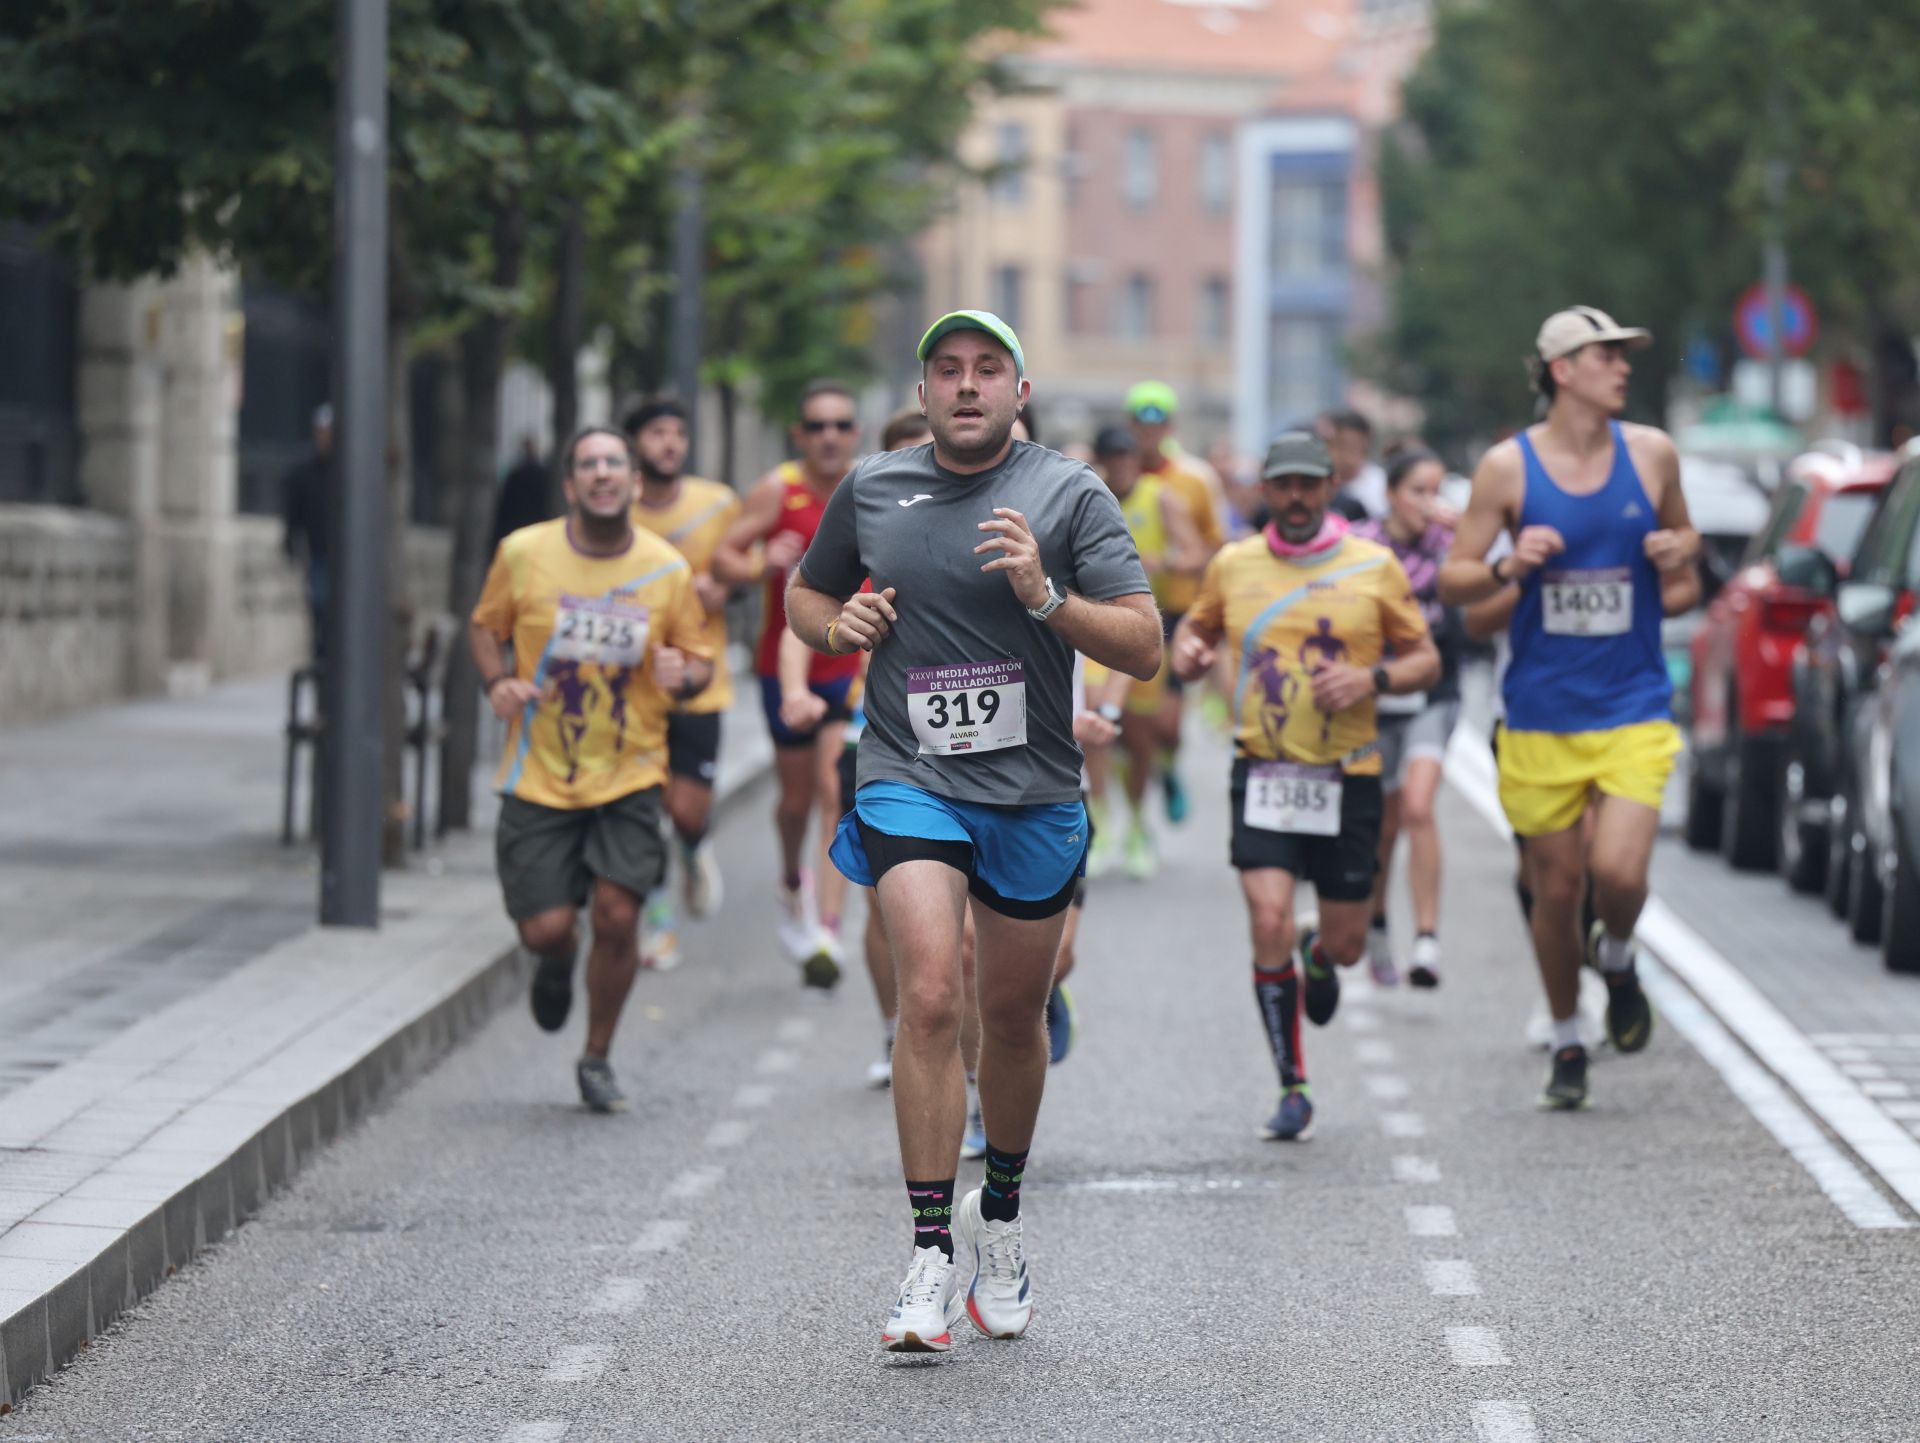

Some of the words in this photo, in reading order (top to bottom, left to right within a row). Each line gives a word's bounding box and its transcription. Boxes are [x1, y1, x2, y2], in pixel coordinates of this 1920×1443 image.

[1552, 585, 1621, 614] 1403
[561, 613, 634, 650] 2125
[909, 671, 934, 681] XXXVI
[936, 668, 969, 679] MEDIA
[971, 660, 1022, 676] MARATÓN
[930, 682, 942, 691] DE
[944, 674, 1009, 689] VALLADOLID
[926, 689, 1000, 729] 319
[949, 730, 979, 740] ALVARO
[1259, 780, 1328, 812] 1385
